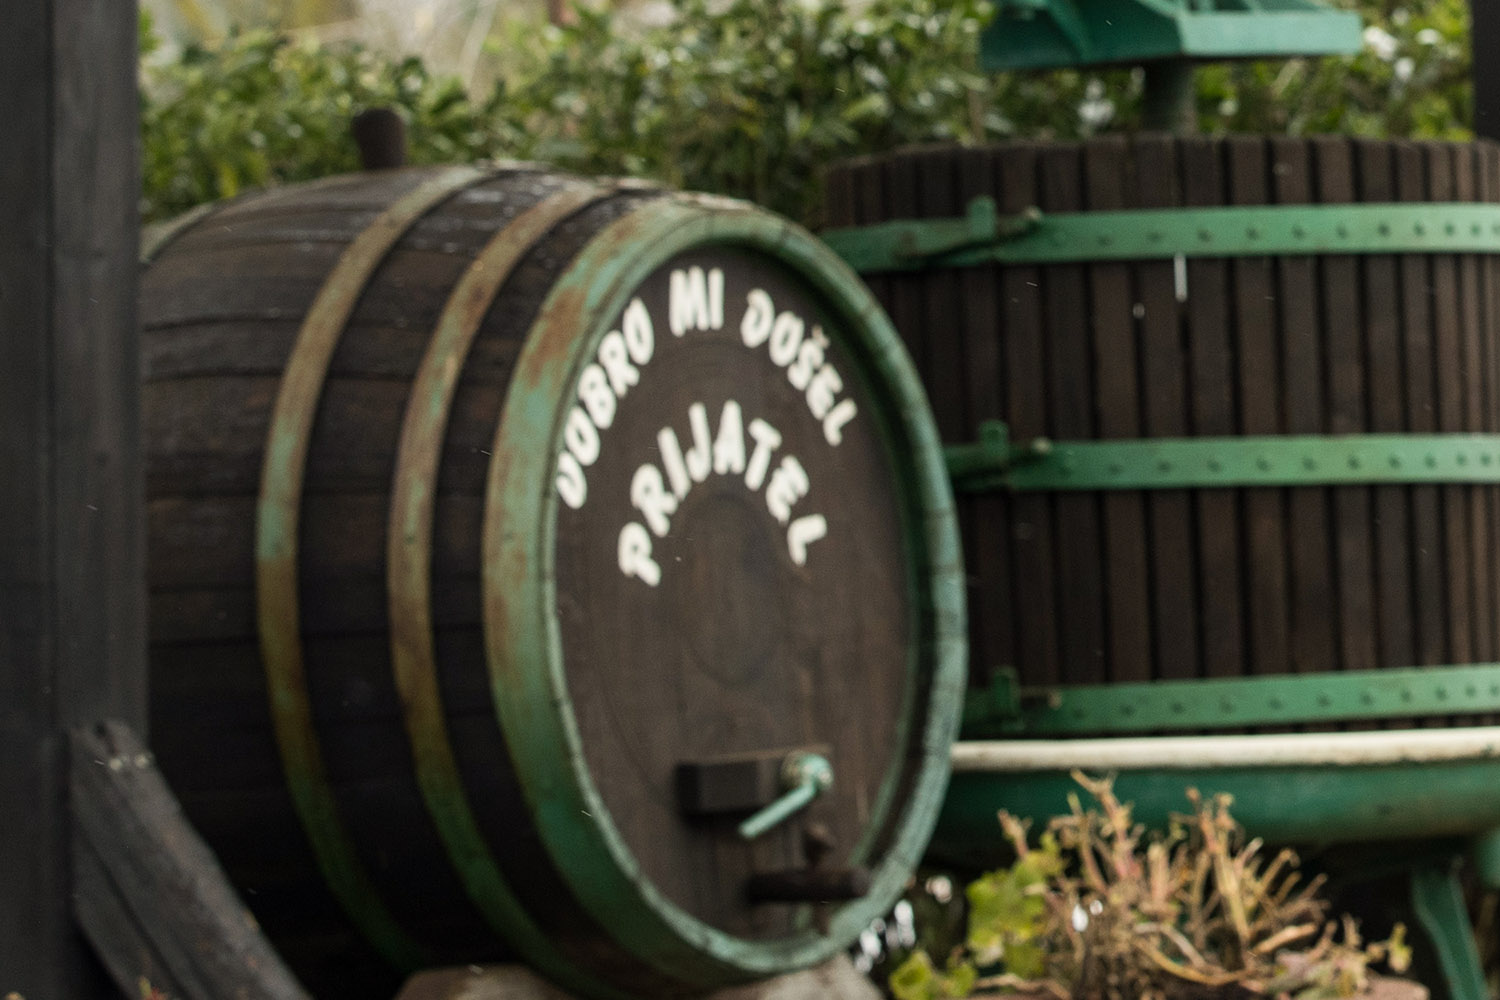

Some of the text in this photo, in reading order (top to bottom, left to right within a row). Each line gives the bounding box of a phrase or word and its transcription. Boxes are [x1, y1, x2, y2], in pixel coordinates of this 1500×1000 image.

[555, 265, 859, 510] DOBRO MI DOŠEL
[616, 399, 829, 588] PRIJATEL
